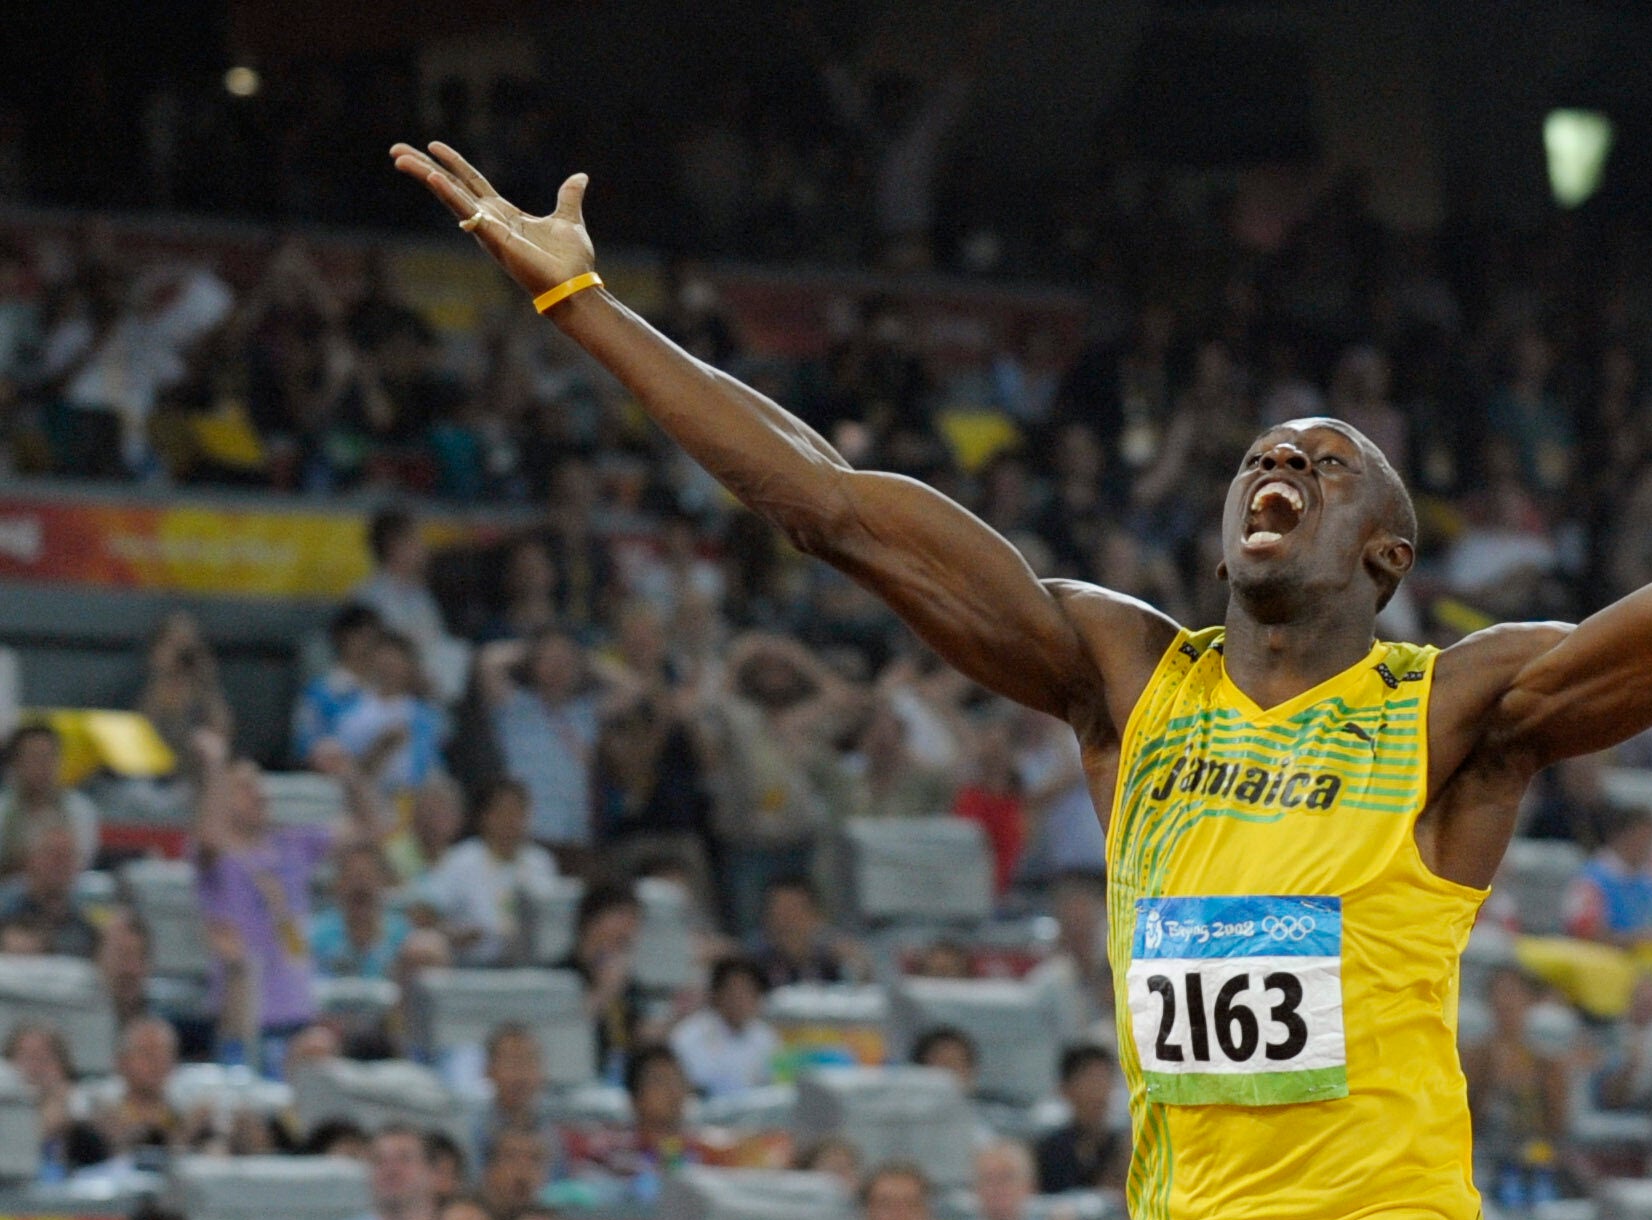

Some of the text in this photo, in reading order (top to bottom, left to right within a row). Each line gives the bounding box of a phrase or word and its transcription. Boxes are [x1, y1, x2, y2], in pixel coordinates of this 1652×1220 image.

[1165, 919, 1256, 944] Beijing 2008
[1147, 971, 1308, 1063] 2163
